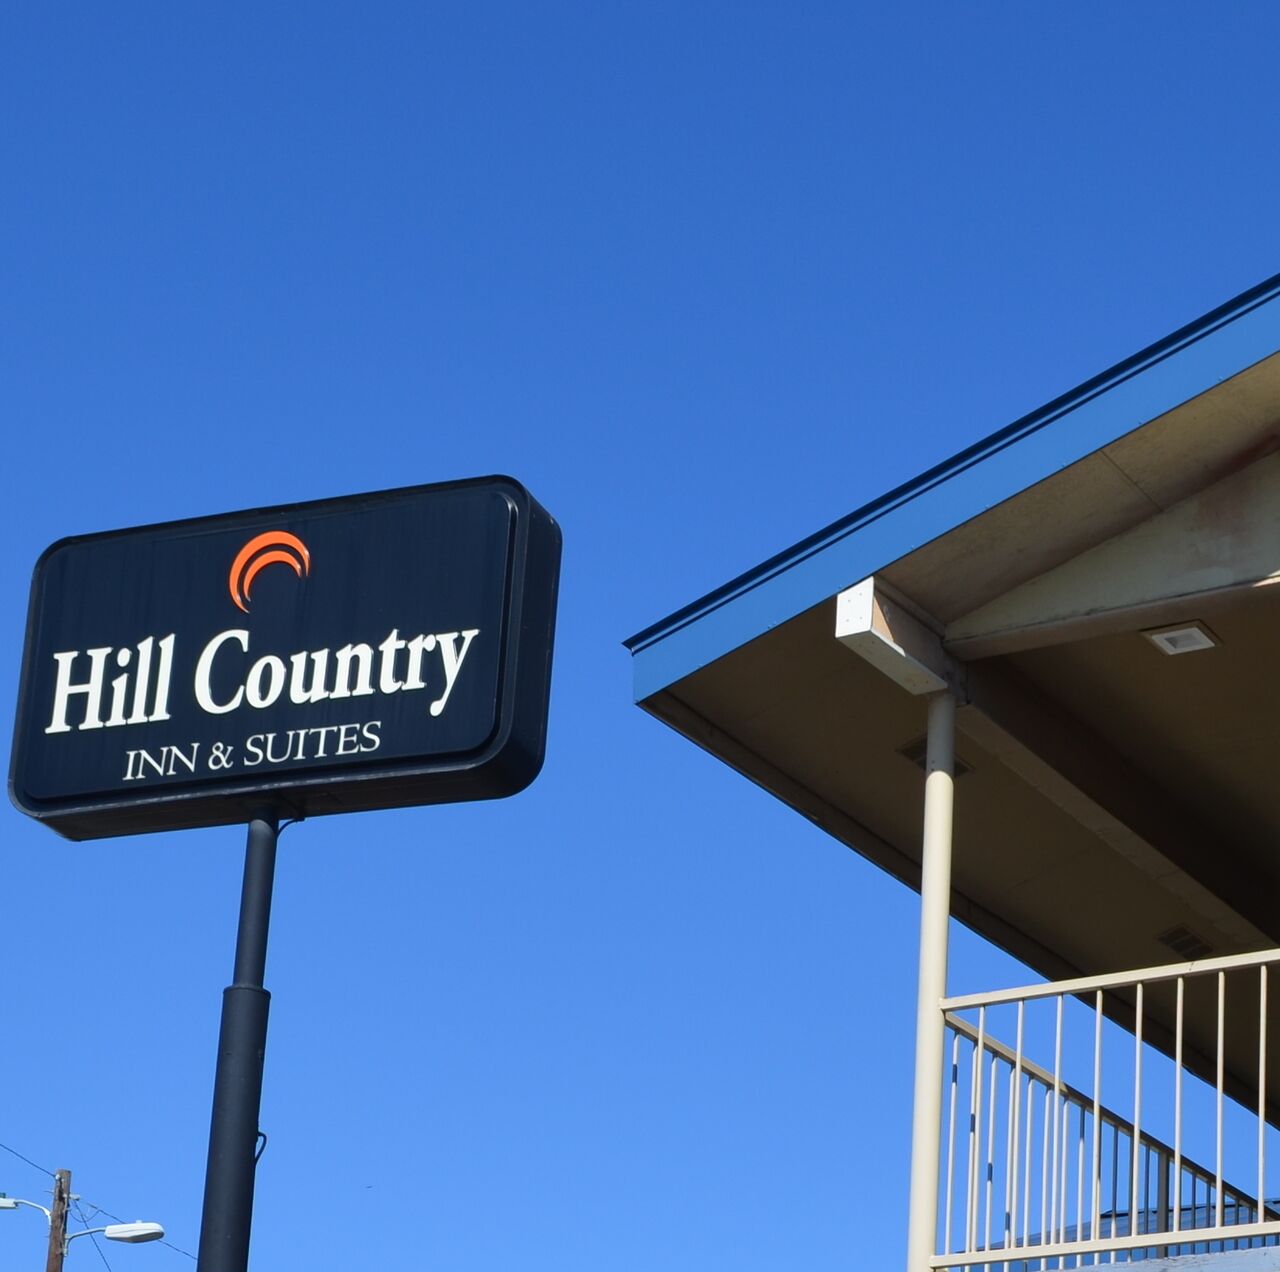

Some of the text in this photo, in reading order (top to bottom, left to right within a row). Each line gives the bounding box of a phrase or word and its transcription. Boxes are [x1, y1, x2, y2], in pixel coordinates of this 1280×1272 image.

[45, 628, 480, 733] Hill Country
[122, 721, 382, 781] INN & SUITES
